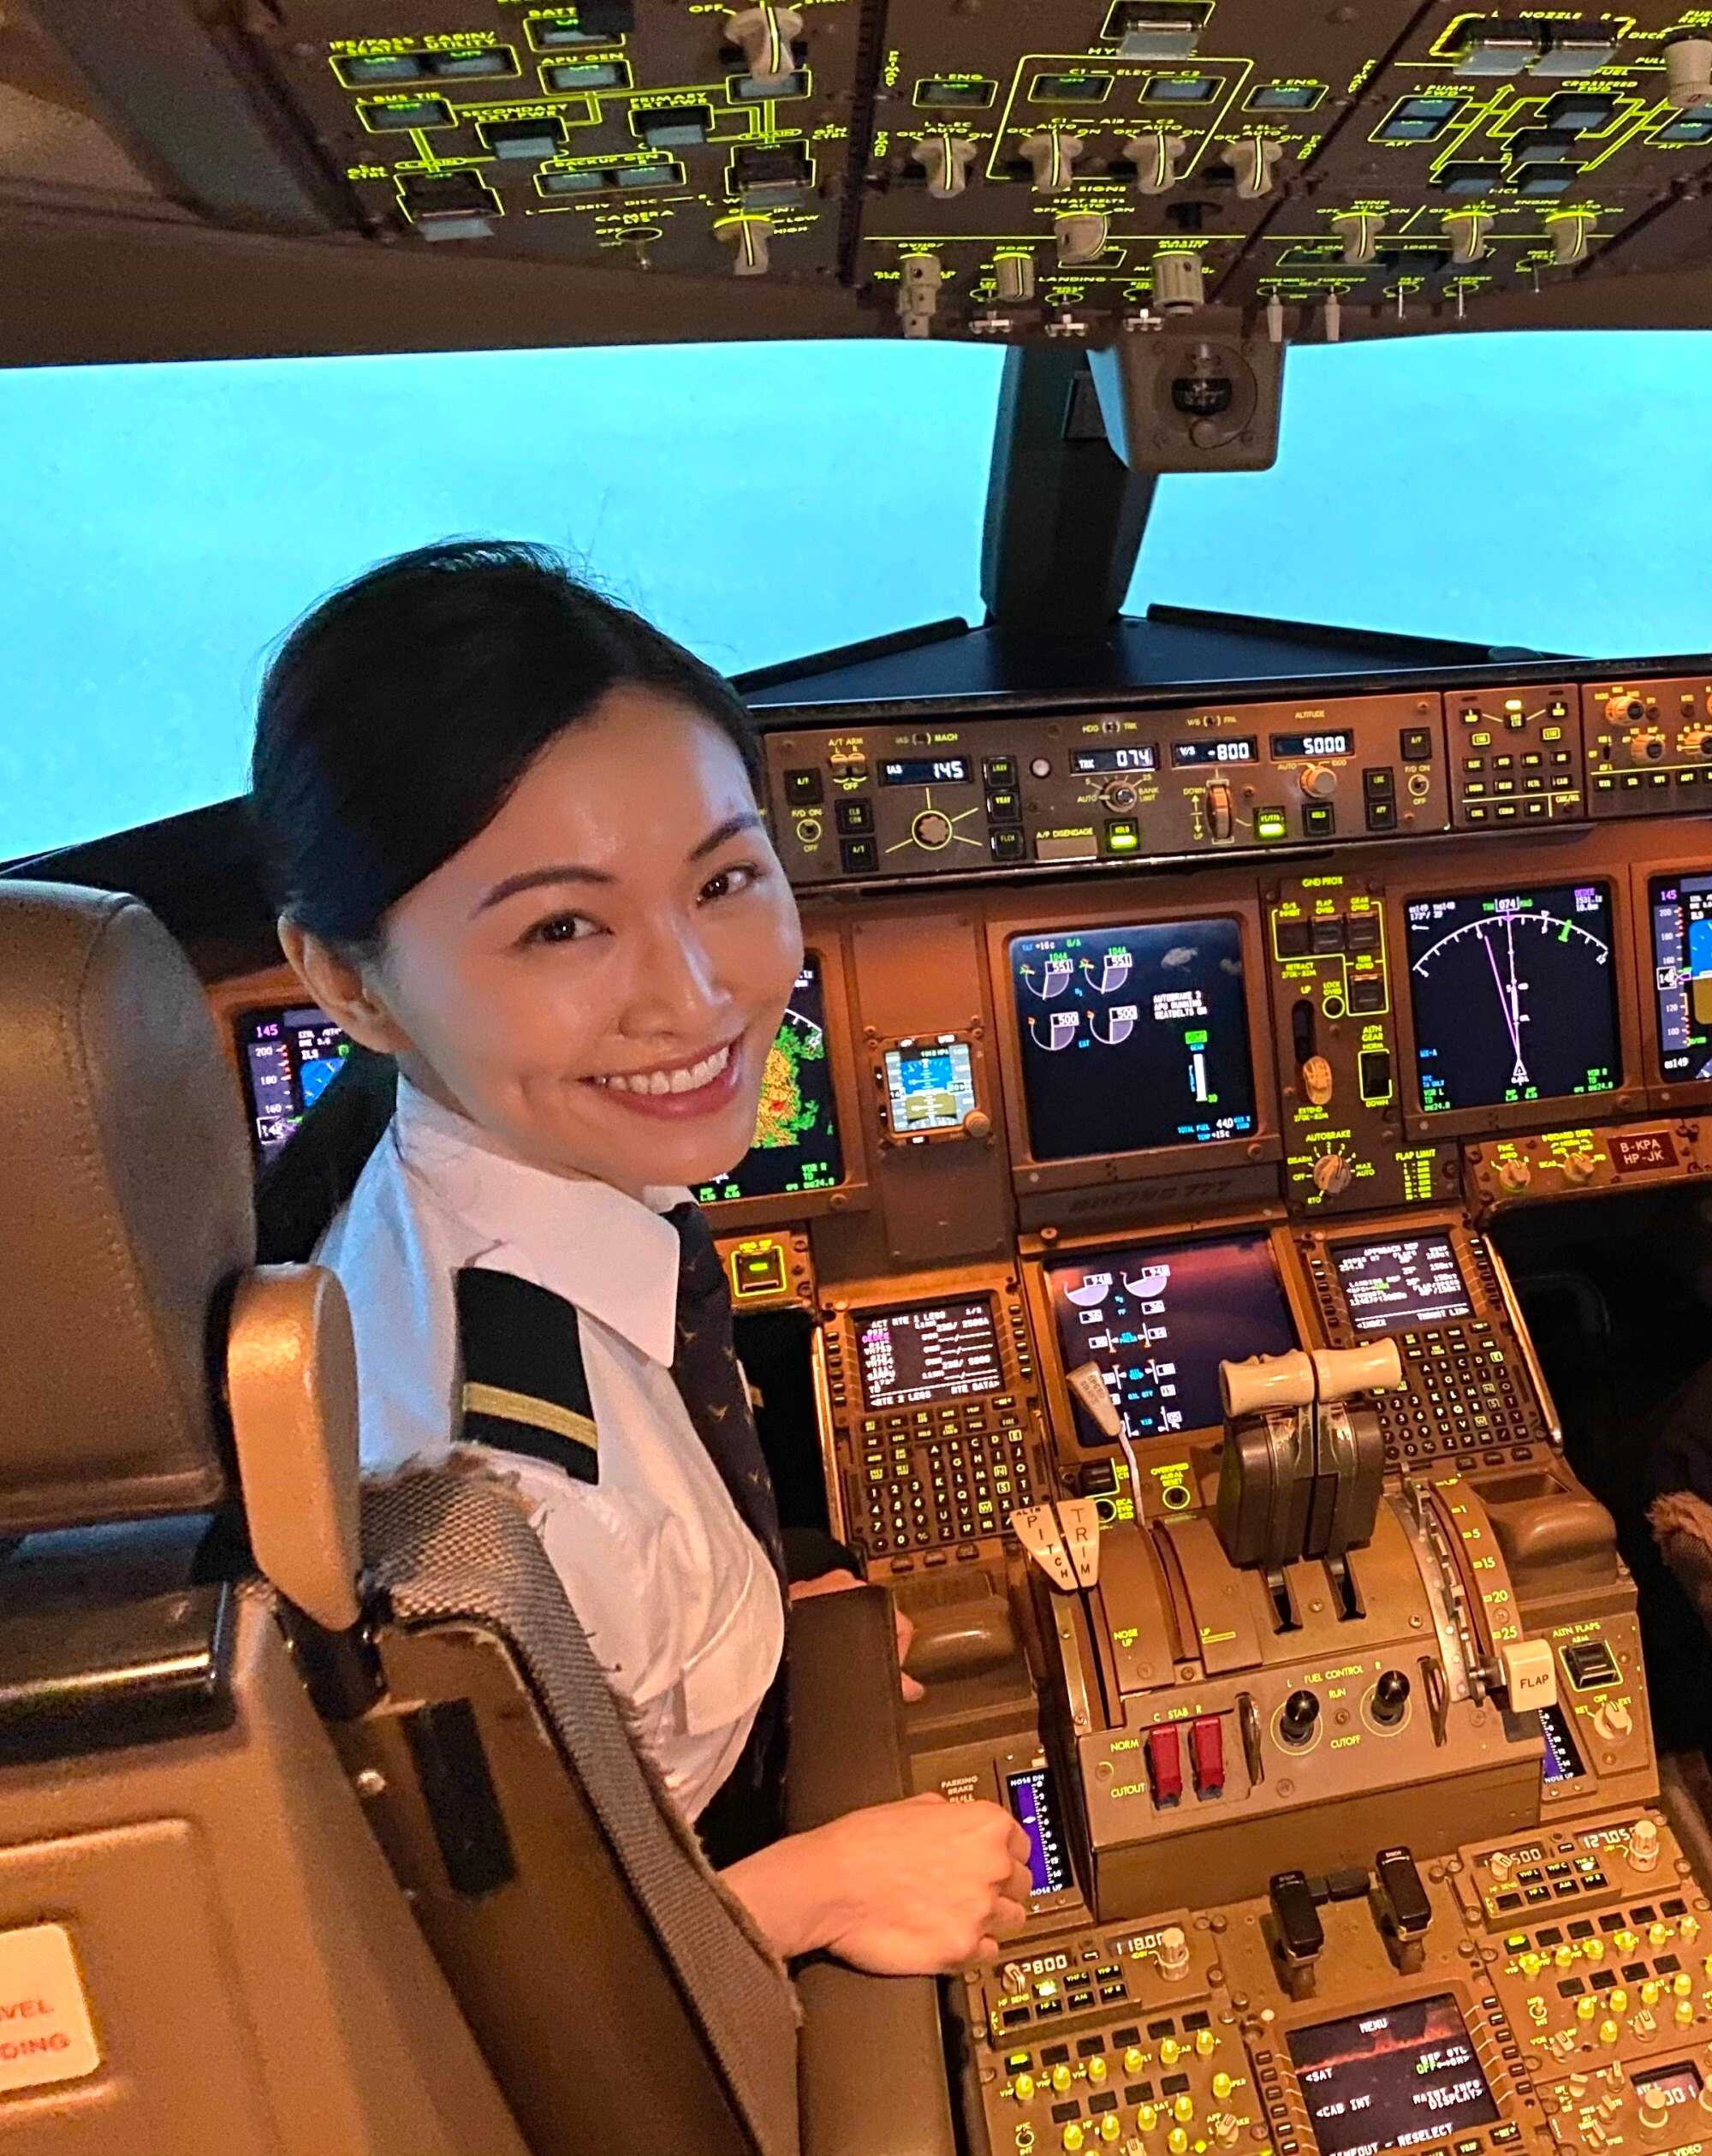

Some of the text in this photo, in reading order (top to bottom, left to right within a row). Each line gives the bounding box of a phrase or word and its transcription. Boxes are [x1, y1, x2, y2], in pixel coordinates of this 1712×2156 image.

[529, 8, 576, 18] BATT
[688, 4, 722, 14] OFF
[1519, 10, 1582, 20] NOZZLE
[542, 52, 623, 65] APU GEN
[631, 92, 705, 104] PRIMARY
[463, 104, 568, 117] SECONDARY
[555, 153, 657, 168] BACKUP GEN
[595, 210, 674, 222] CAMERA
[1294, 710, 1325, 719] ALTITUDE
[829, 736, 863, 747] A/T ARM
[1303, 736, 1345, 754] 5000
[1180, 742, 1249, 760] V/S -800
[1079, 750, 1152, 769] TRK 074
[887, 762, 964, 779] IAS 145
[843, 782, 859, 790] OFF
[1053, 828, 1093, 837] DISENGAGE
[1303, 877, 1343, 888] GND PROX
[1661, 890, 1677, 901] 145
[1300, 986, 1311, 995] UP
[257, 1024, 278, 1038] 145
[1362, 1033, 1383, 1042] GEAR
[255, 1046, 273, 1057] 200
[1196, 1123, 1210, 1132] FUEL
[1305, 1129, 1351, 1142] AUTOBRAKE
[1620, 1139, 1660, 1153] B-KPA
[1395, 1149, 1436, 1161] FLAP LIMIT
[1624, 1151, 1663, 1164] HP-JK
[1307, 1196, 1322, 1205] RTO
[892, 1316, 909, 1326] RTE
[930, 1445, 939, 1454] A
[1150, 1462, 1189, 1477] OVERSPEED
[957, 1474, 963, 1483] L
[892, 1485, 898, 1493] 2
[917, 1515, 924, 1523] 9
[874, 1522, 881, 1530] 7
[1472, 1528, 1481, 1539] 5
[1482, 1557, 1495, 1569] 15
[1492, 1591, 1508, 1603] 20
[1114, 1629, 1138, 1641] NOSE
[1200, 1629, 1210, 1637] UP
[1501, 1628, 1518, 1640] 25
[1553, 1622, 1601, 1641] ALTN FLAPS
[1121, 1639, 1133, 1647] UP
[1287, 1661, 1382, 1688] L FUEL CONTROL R
[1519, 1674, 1549, 1689] FLAP
[1329, 1688, 1346, 1700] RUN
[1594, 1694, 1632, 1706] OFF EXT
[1154, 1705, 1202, 1723] C STAB R
[1575, 1706, 1588, 1715] RET
[1110, 1739, 1139, 1752] NORM
[1330, 1735, 1361, 1750] CUTOFF
[942, 1775, 978, 1790] PARKING
[1010, 1777, 1031, 1787] NOSE
[1565, 1772, 1574, 1781] UP
[948, 1784, 974, 1796] BRAKE
[1111, 1783, 1145, 1799] CUTOUT
[1030, 1884, 1062, 1897] NOSE UP
[1359, 2017, 1388, 2034] MENU
[1072, 2070, 1087, 2079] VHF
[1036, 2079, 1050, 2089] VHF
[1000, 2088, 1014, 2098] VHF
[1349, 2094, 1371, 2111] INT
[1397, 2123, 1453, 2148] RESELECT
